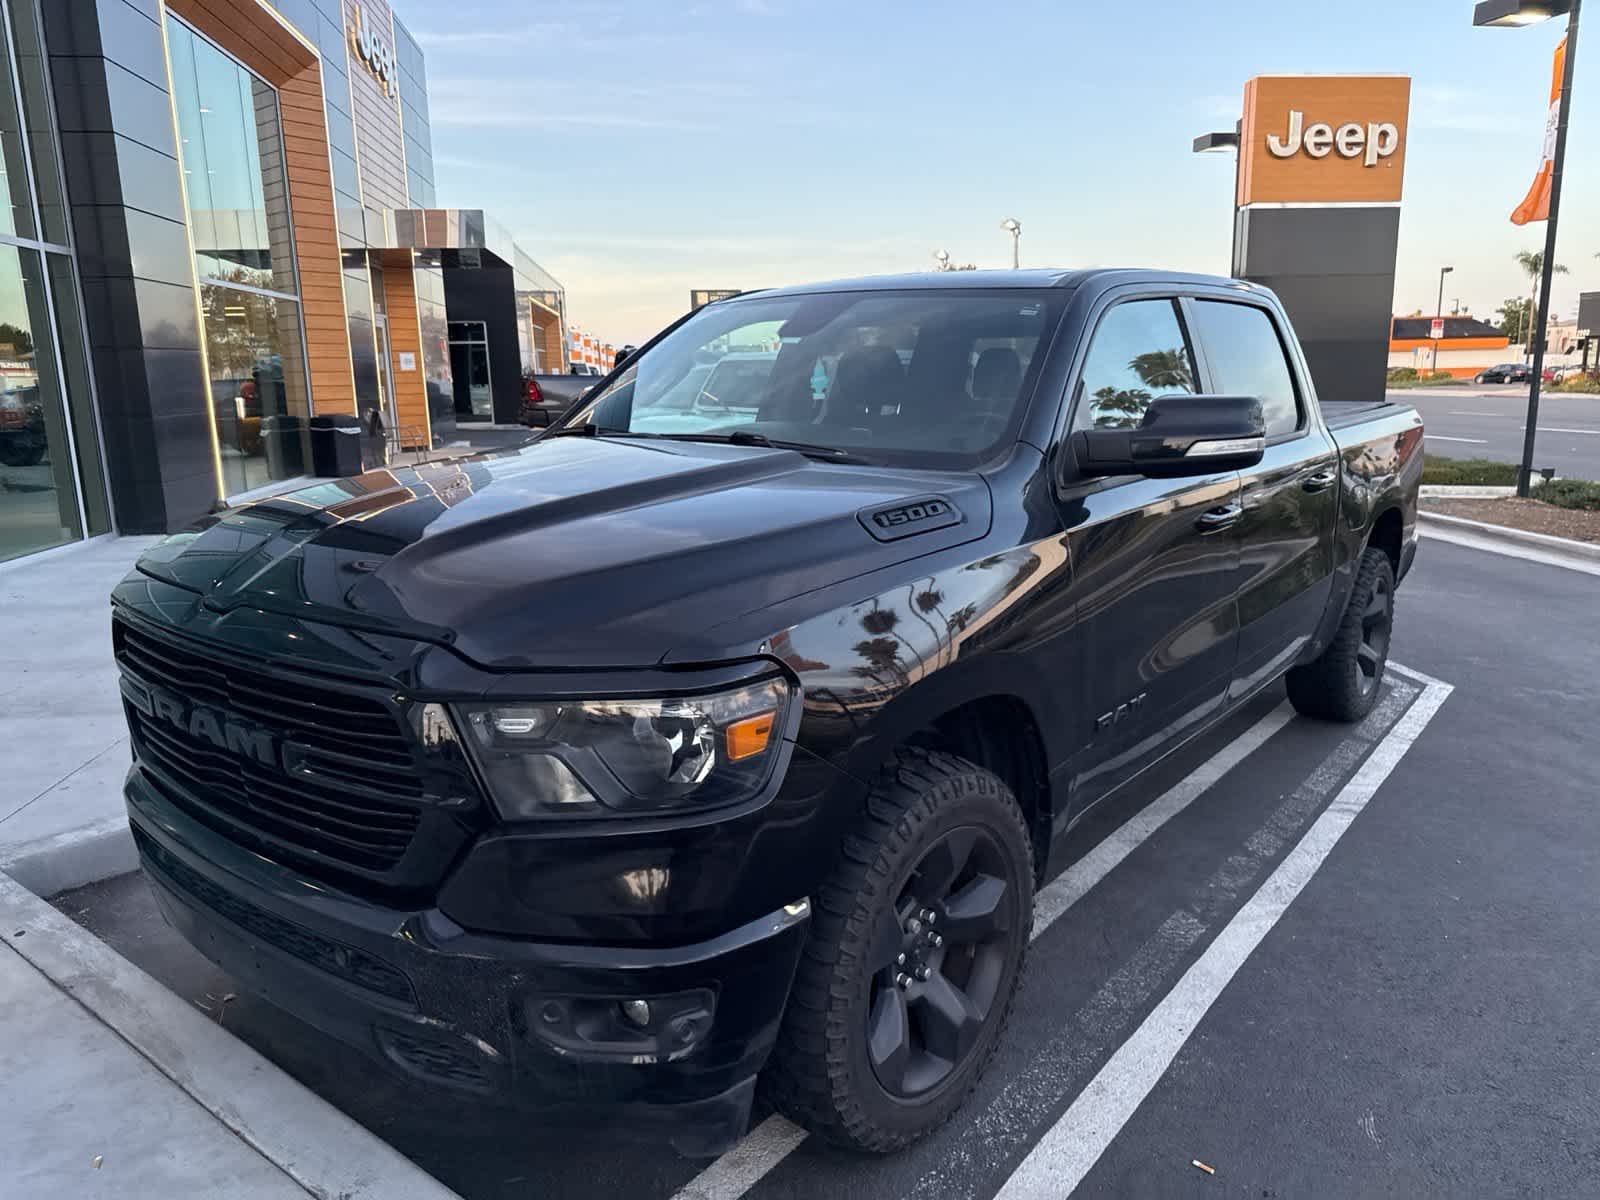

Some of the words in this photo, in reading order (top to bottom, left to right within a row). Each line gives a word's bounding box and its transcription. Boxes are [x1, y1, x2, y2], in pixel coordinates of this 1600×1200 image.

[1266, 109, 1399, 167] Jeep
[875, 501, 946, 527] 1500
[151, 687, 277, 768] RAM
